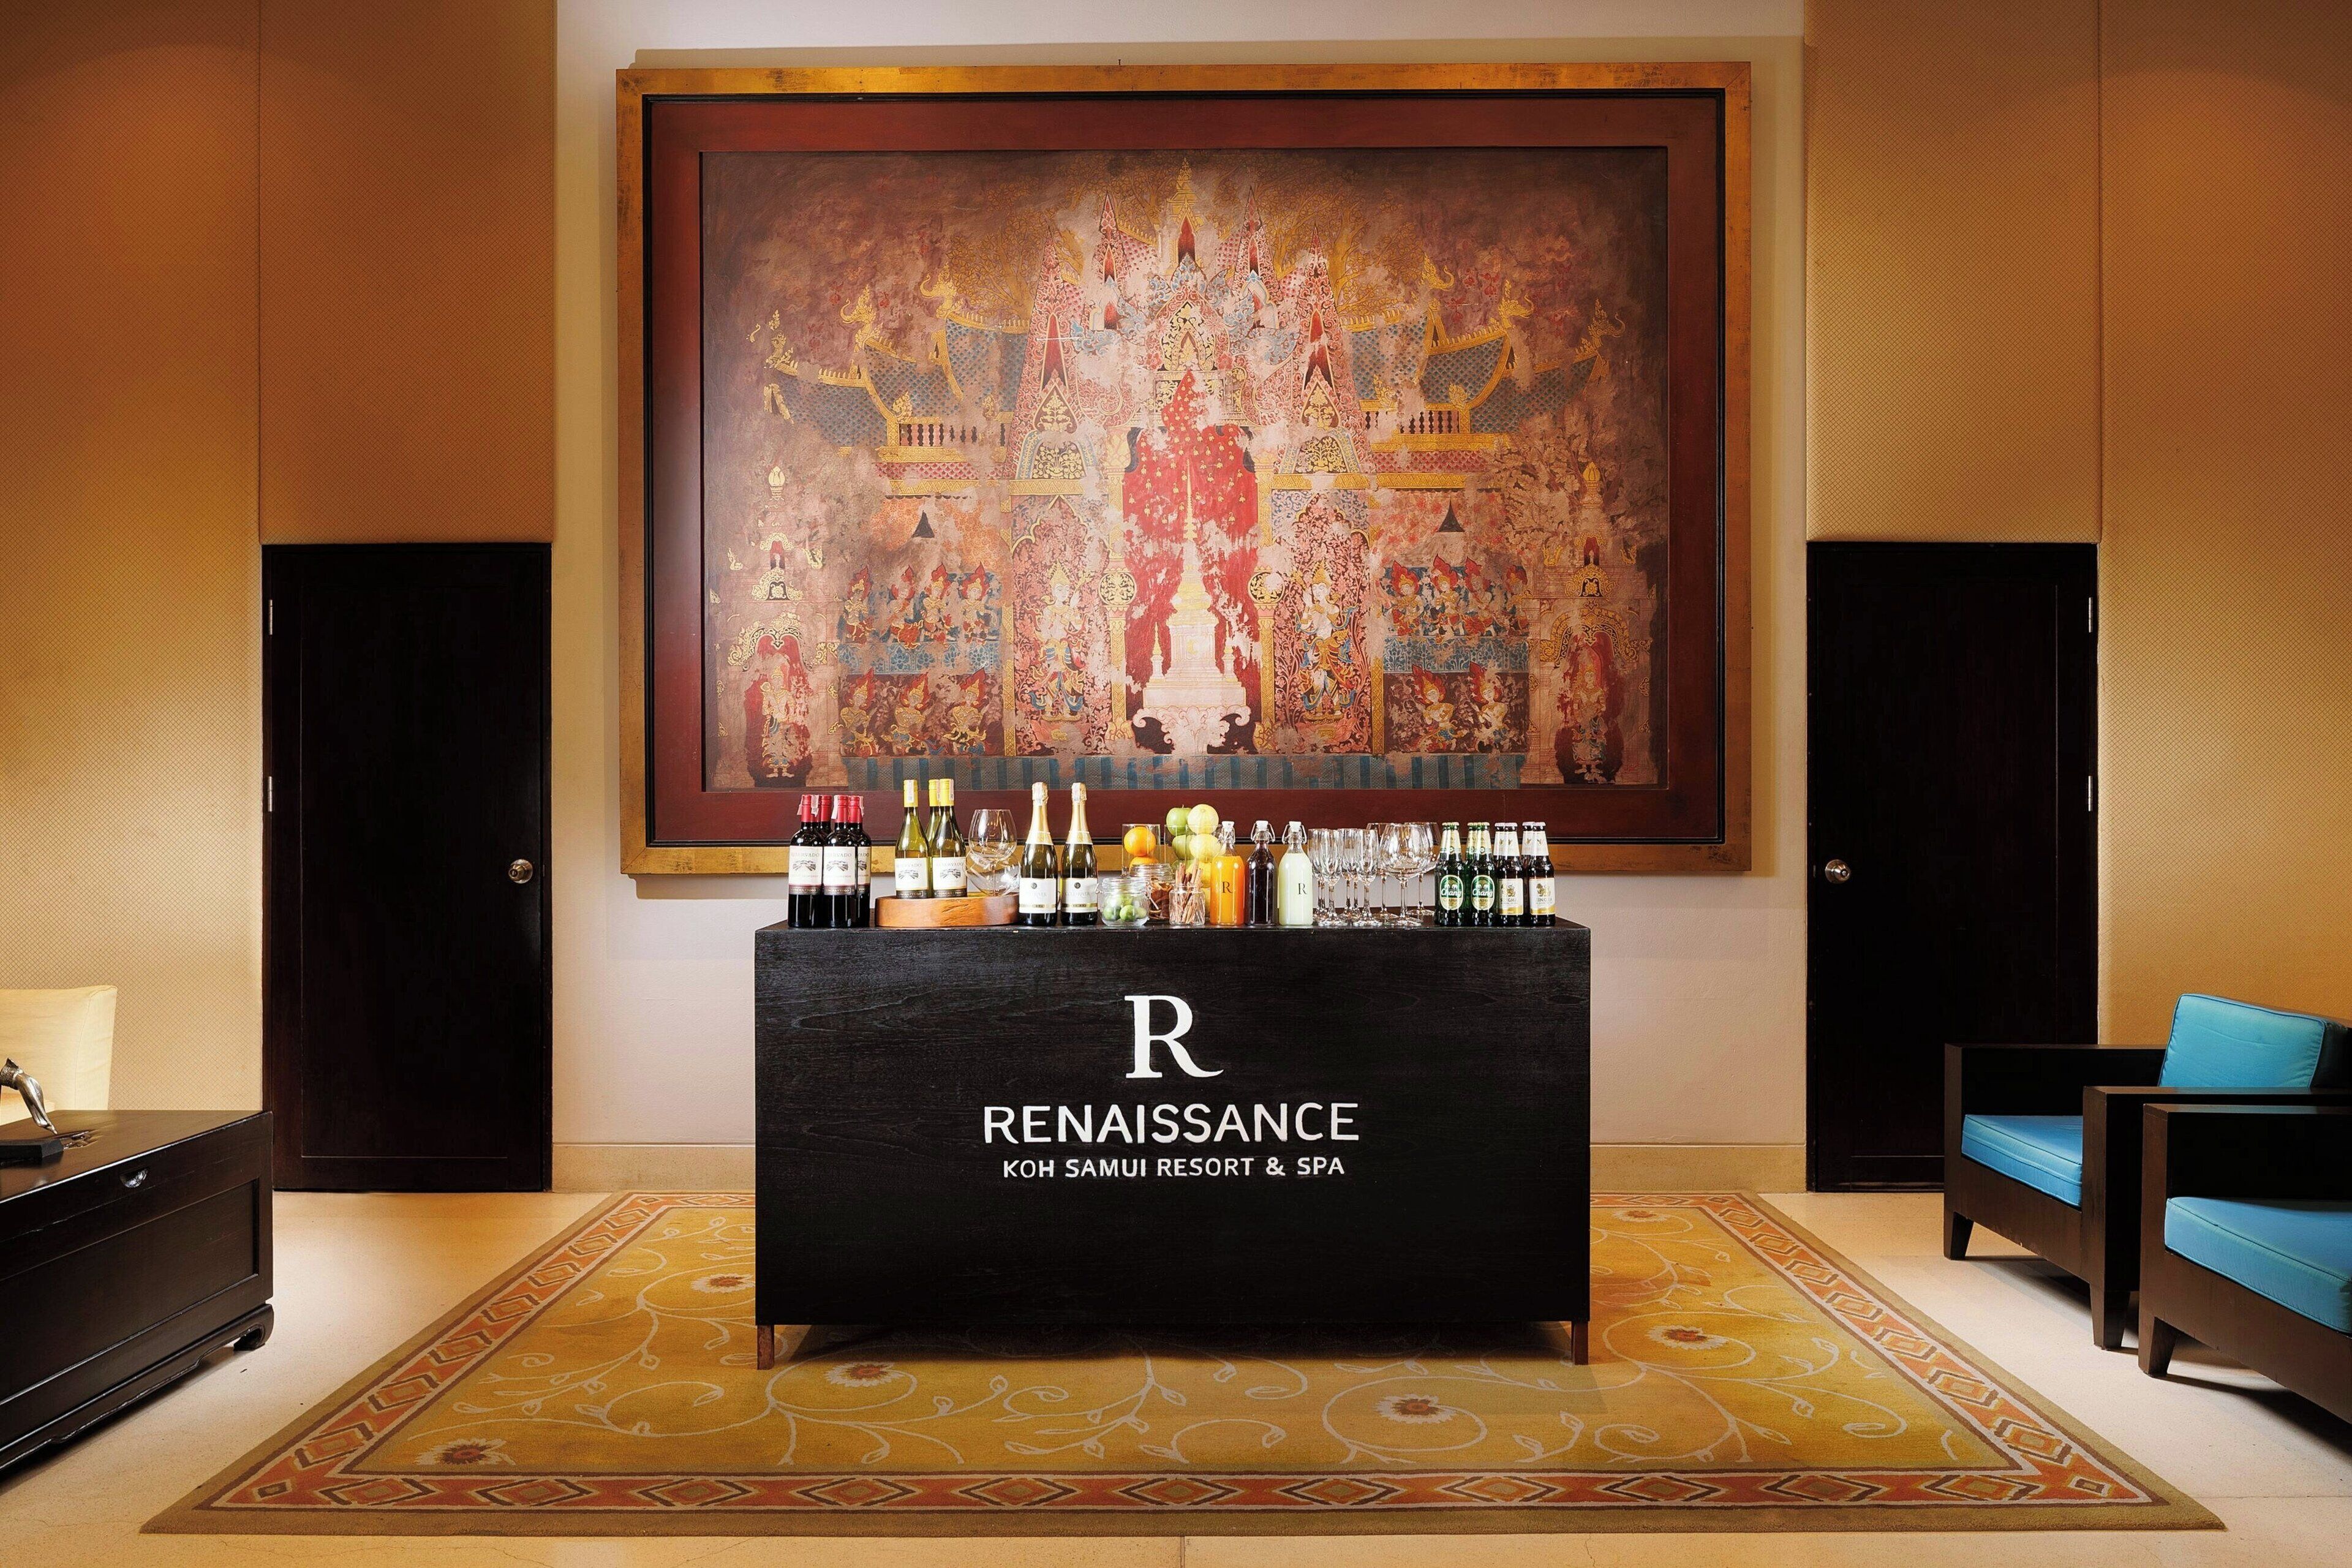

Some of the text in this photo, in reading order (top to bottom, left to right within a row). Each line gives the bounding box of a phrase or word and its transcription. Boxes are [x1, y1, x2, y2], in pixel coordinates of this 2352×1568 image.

[1222, 881, 1232, 893] R
[1298, 883, 1307, 894] R
[1125, 995, 1224, 1078] R
[984, 1102, 1359, 1144] RENAISSANCE
[1003, 1156, 1345, 1178] KOH SAMUI RESORT & SPA
